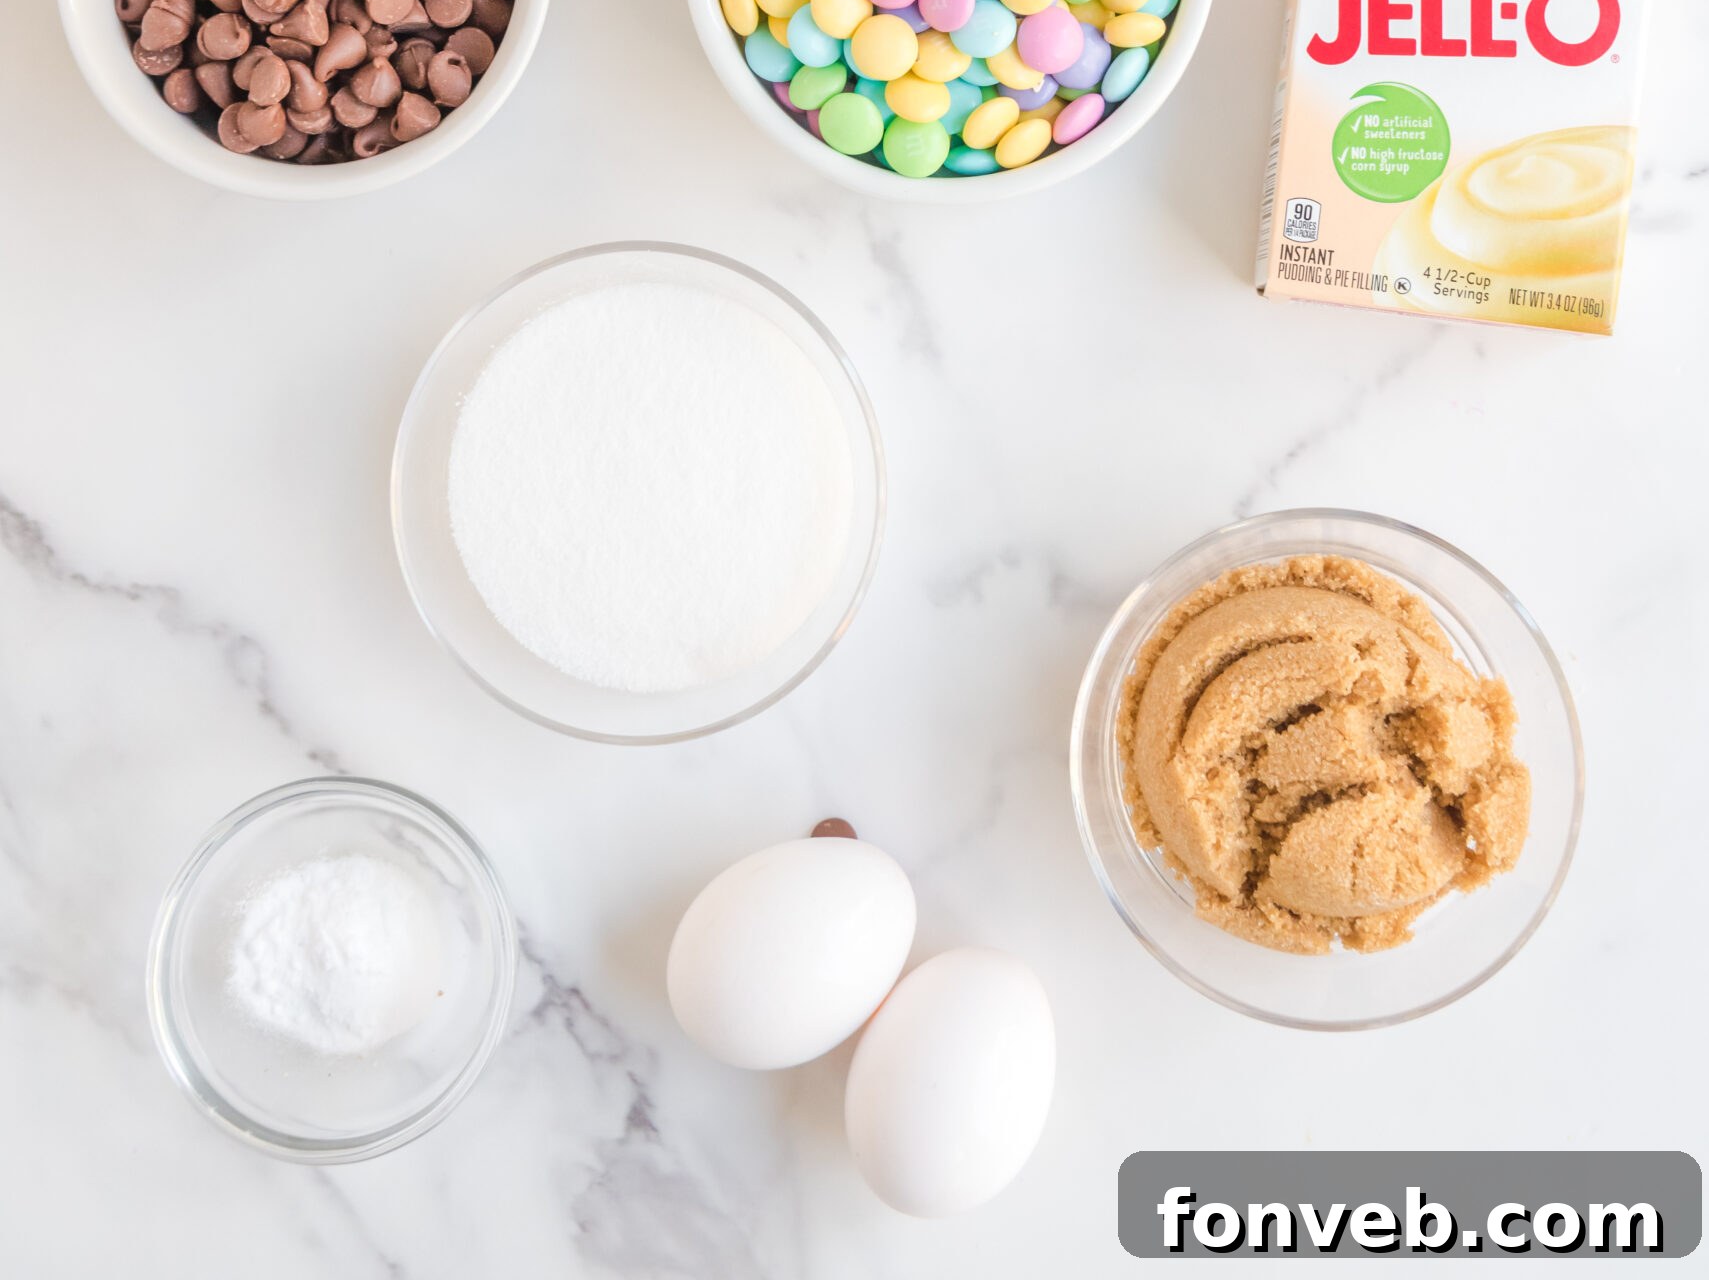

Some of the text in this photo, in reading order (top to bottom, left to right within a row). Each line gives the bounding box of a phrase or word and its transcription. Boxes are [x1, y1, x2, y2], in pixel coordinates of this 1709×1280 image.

[1364, 114, 1433, 128] NO artificial
[1364, 128, 1426, 140] sweeteners
[1351, 146, 1444, 163] NO high fructose
[1351, 162, 1410, 176] corn syrup
[1294, 203, 1313, 221] 90
[1287, 218, 1317, 231] CALORIES
[1280, 244, 1335, 266] INSTANT
[1277, 261, 1388, 292] PUDDING & PIE FILLING
[1423, 267, 1491, 290] 4 1/2-Cup
[1433, 282, 1490, 304] Servings
[1509, 288, 1605, 318] NET WT 3.4 OZ (96g)
